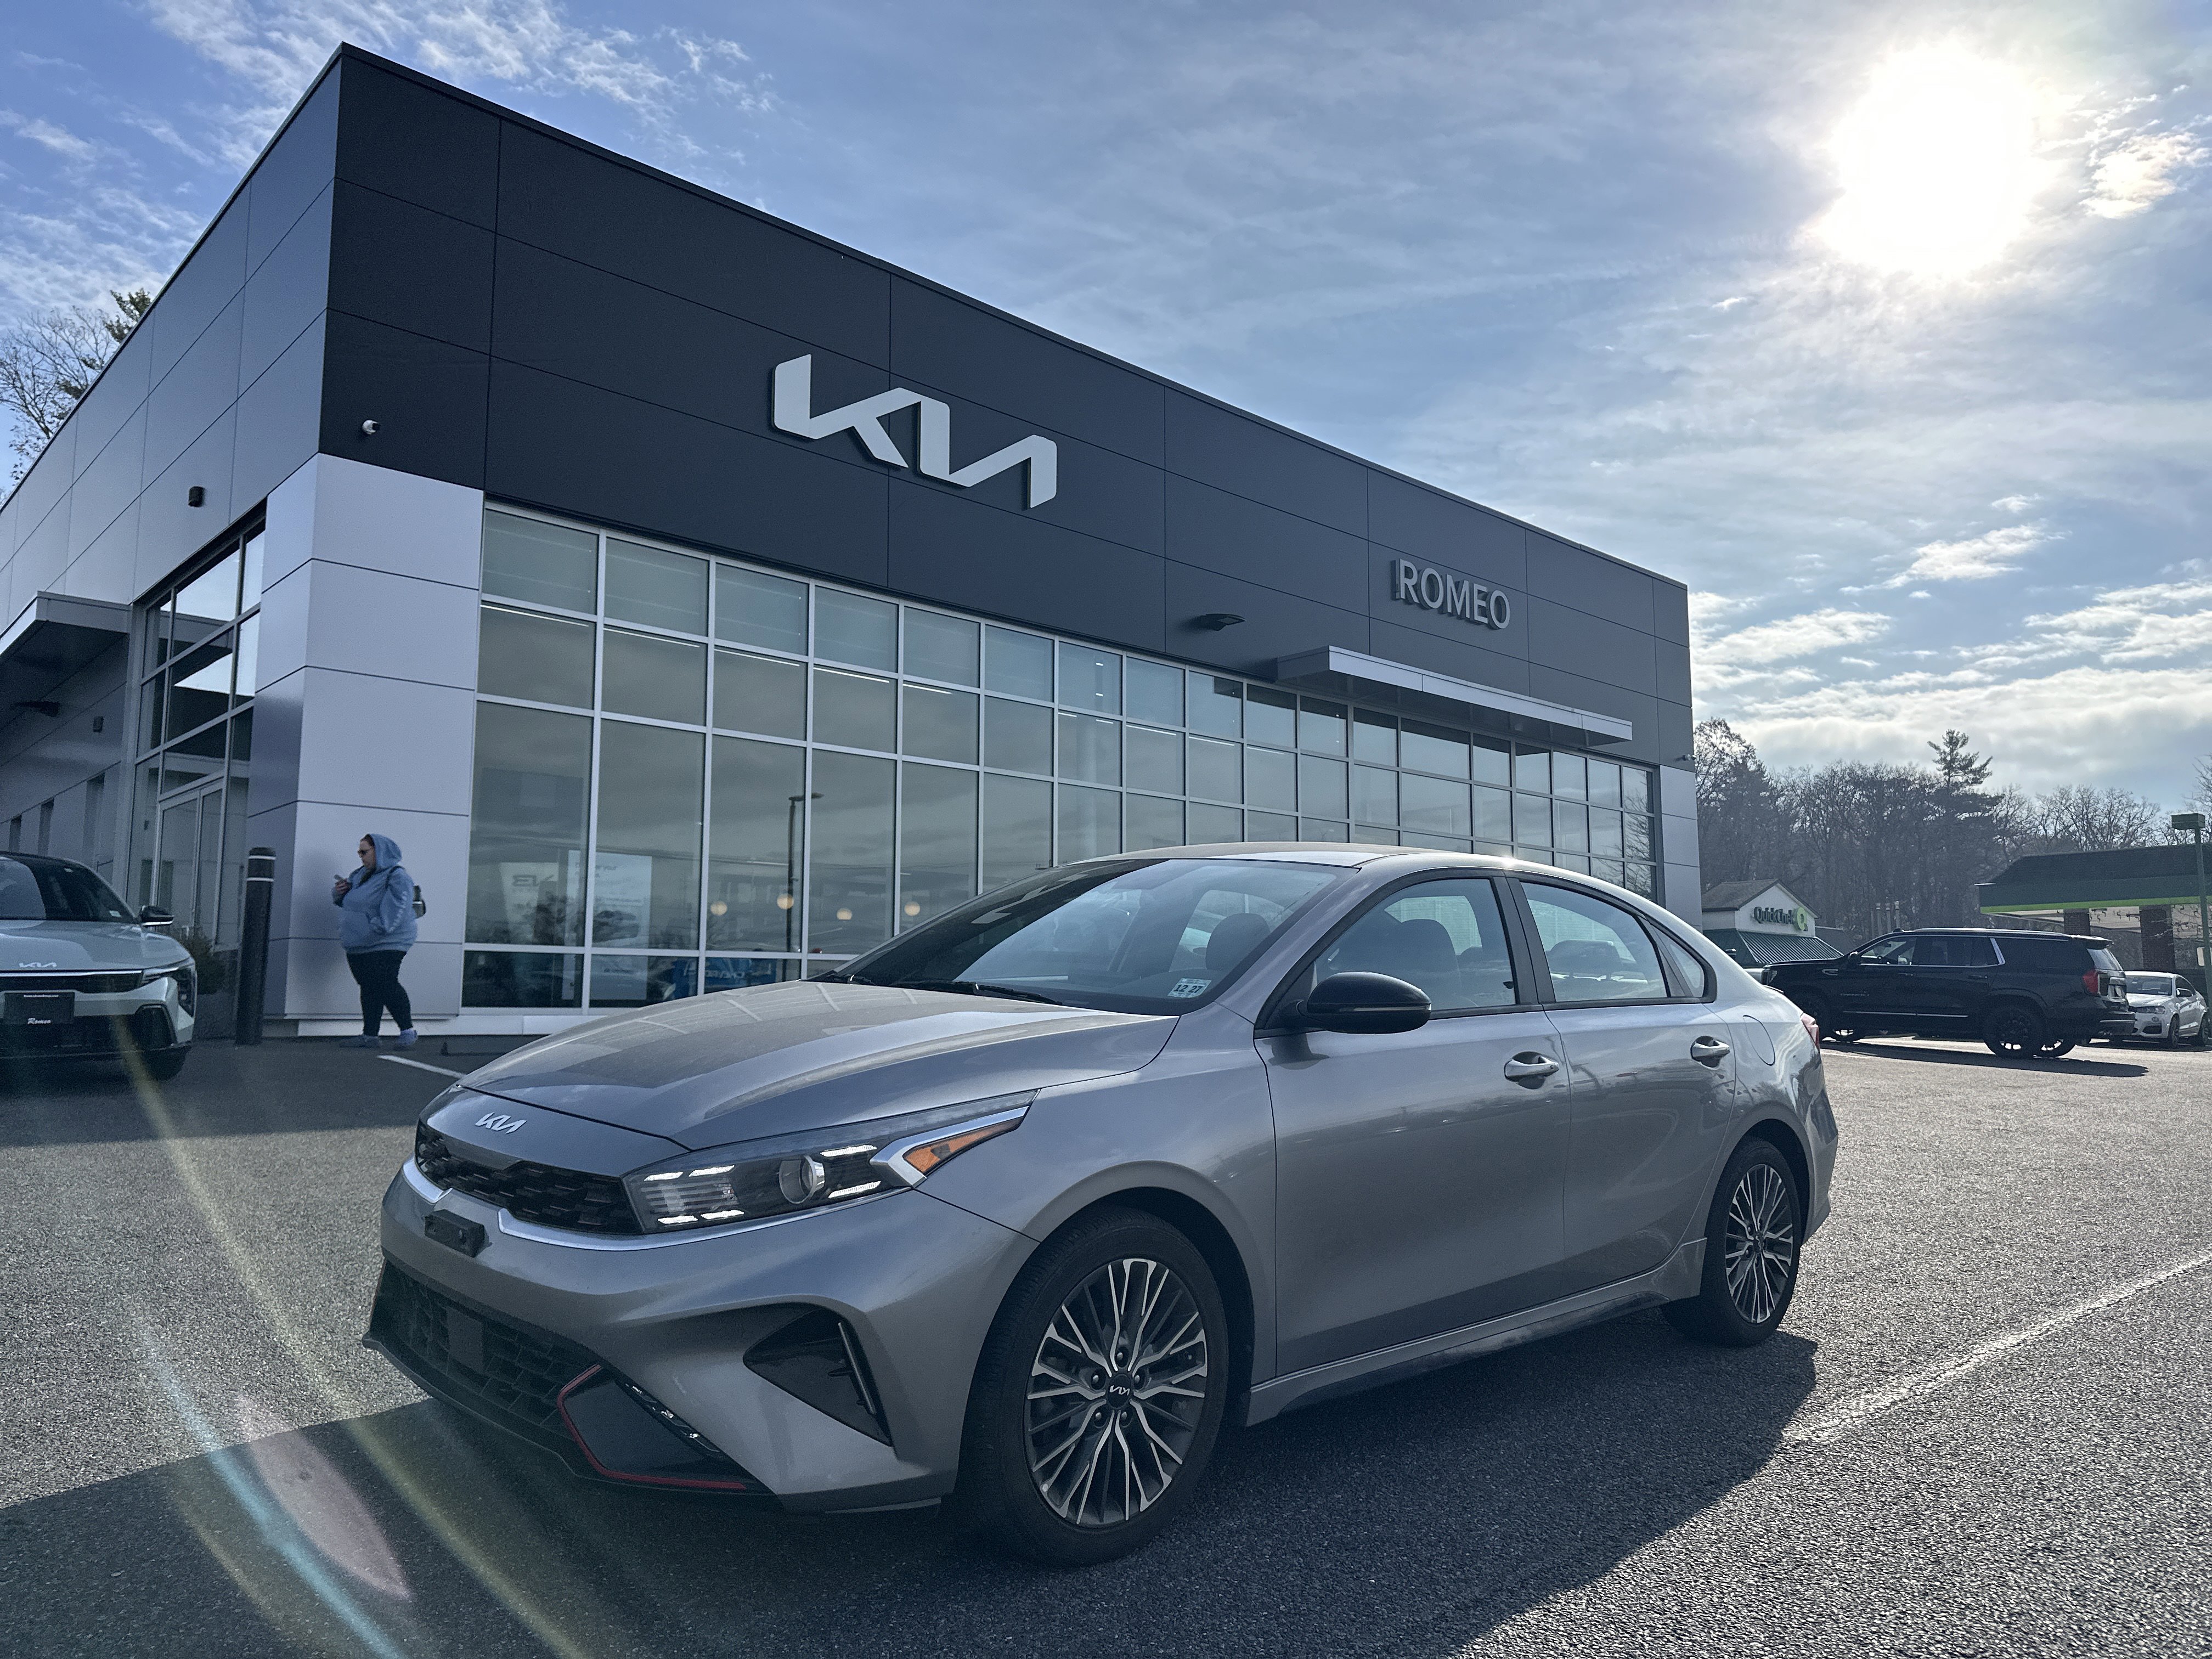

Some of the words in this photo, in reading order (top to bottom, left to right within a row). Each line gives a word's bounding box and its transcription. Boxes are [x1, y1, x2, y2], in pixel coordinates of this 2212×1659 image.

[773, 354, 1057, 509] KIA
[1395, 558, 1510, 629] ROMEO
[475, 1112, 527, 1135] KIA
